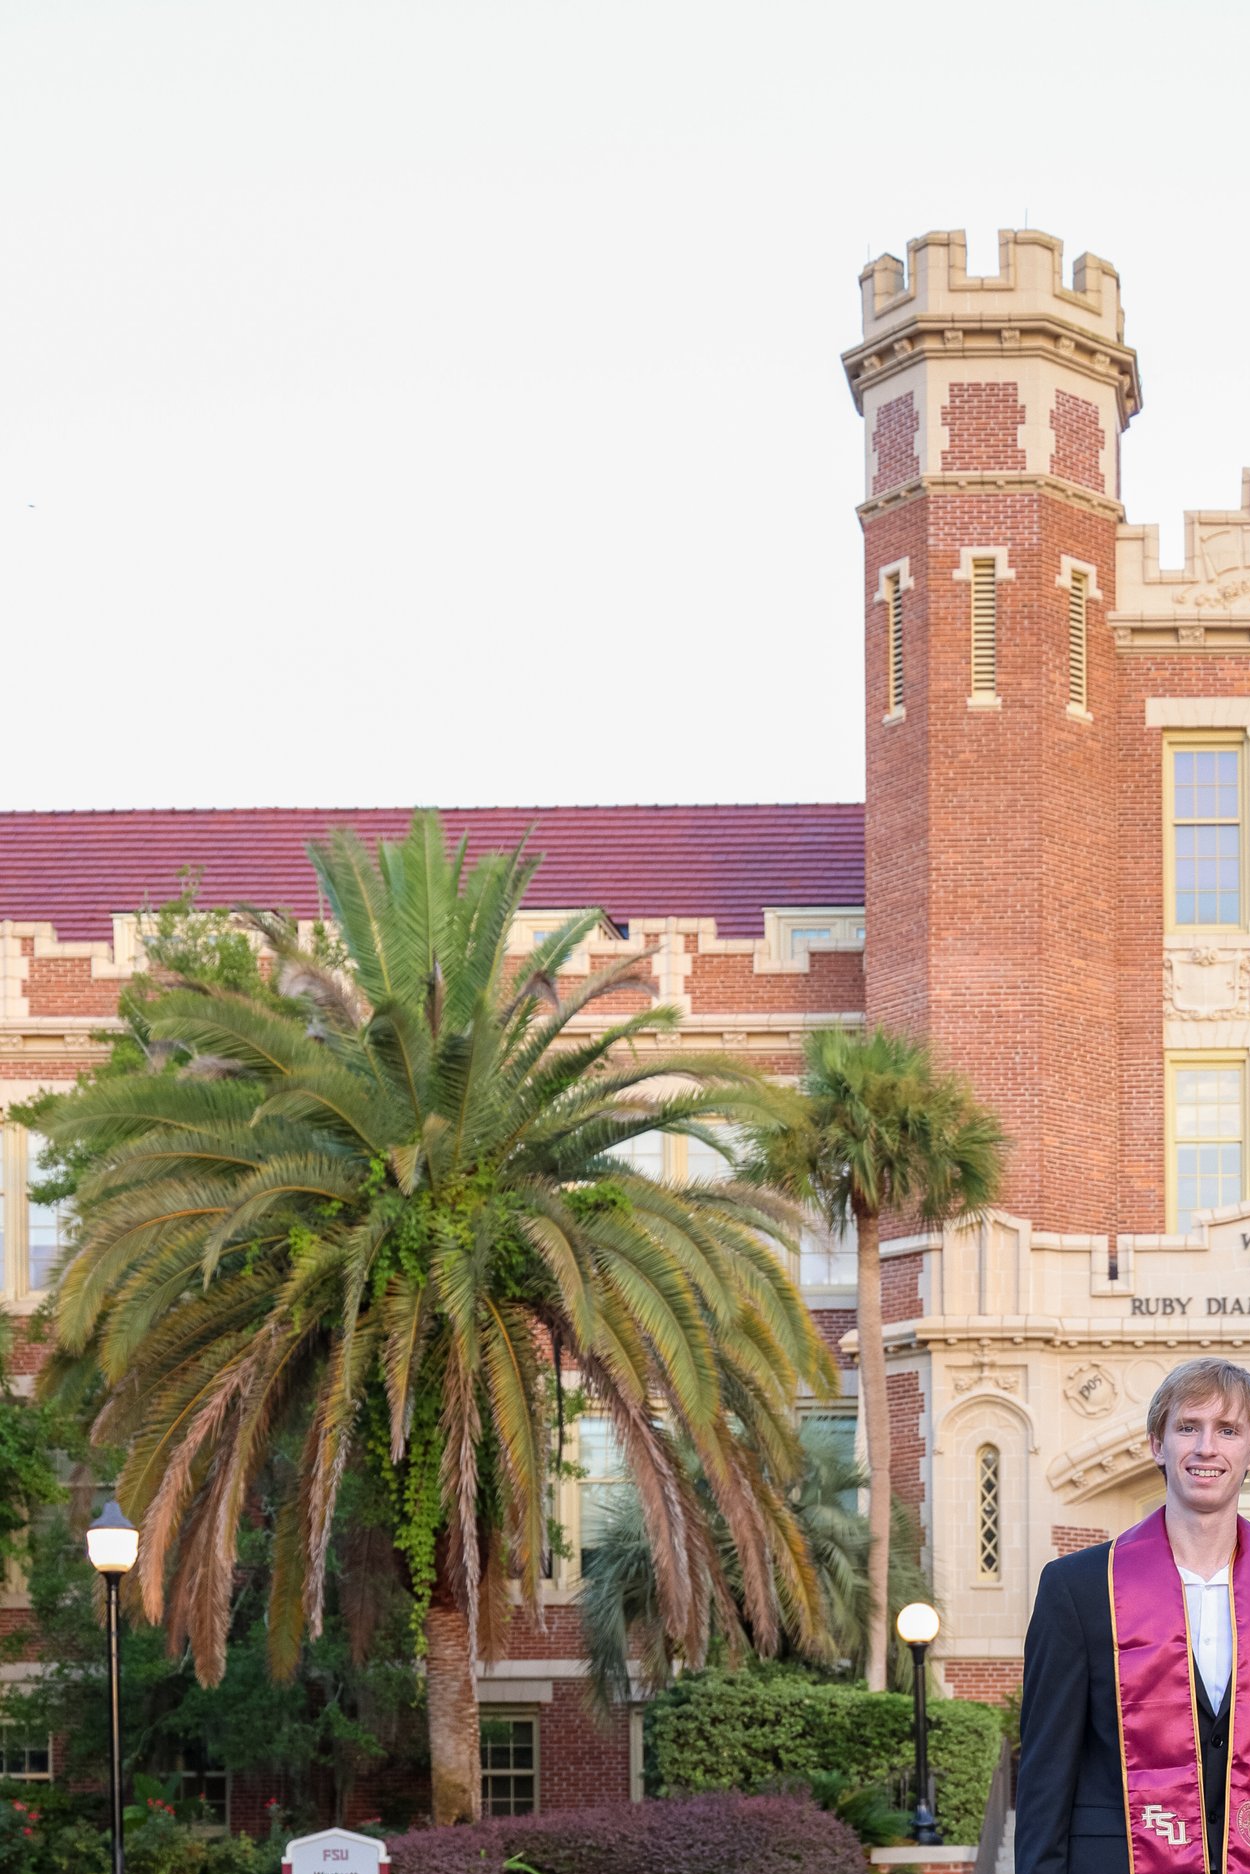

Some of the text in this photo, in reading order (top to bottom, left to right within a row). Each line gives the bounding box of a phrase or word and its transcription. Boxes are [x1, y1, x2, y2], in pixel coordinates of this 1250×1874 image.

[1131, 1297, 1193, 1316] RUBY
[1079, 1374, 1102, 1401] 1905
[1141, 1804, 1187, 1845] FSU
[323, 1849, 349, 1861] FSU
